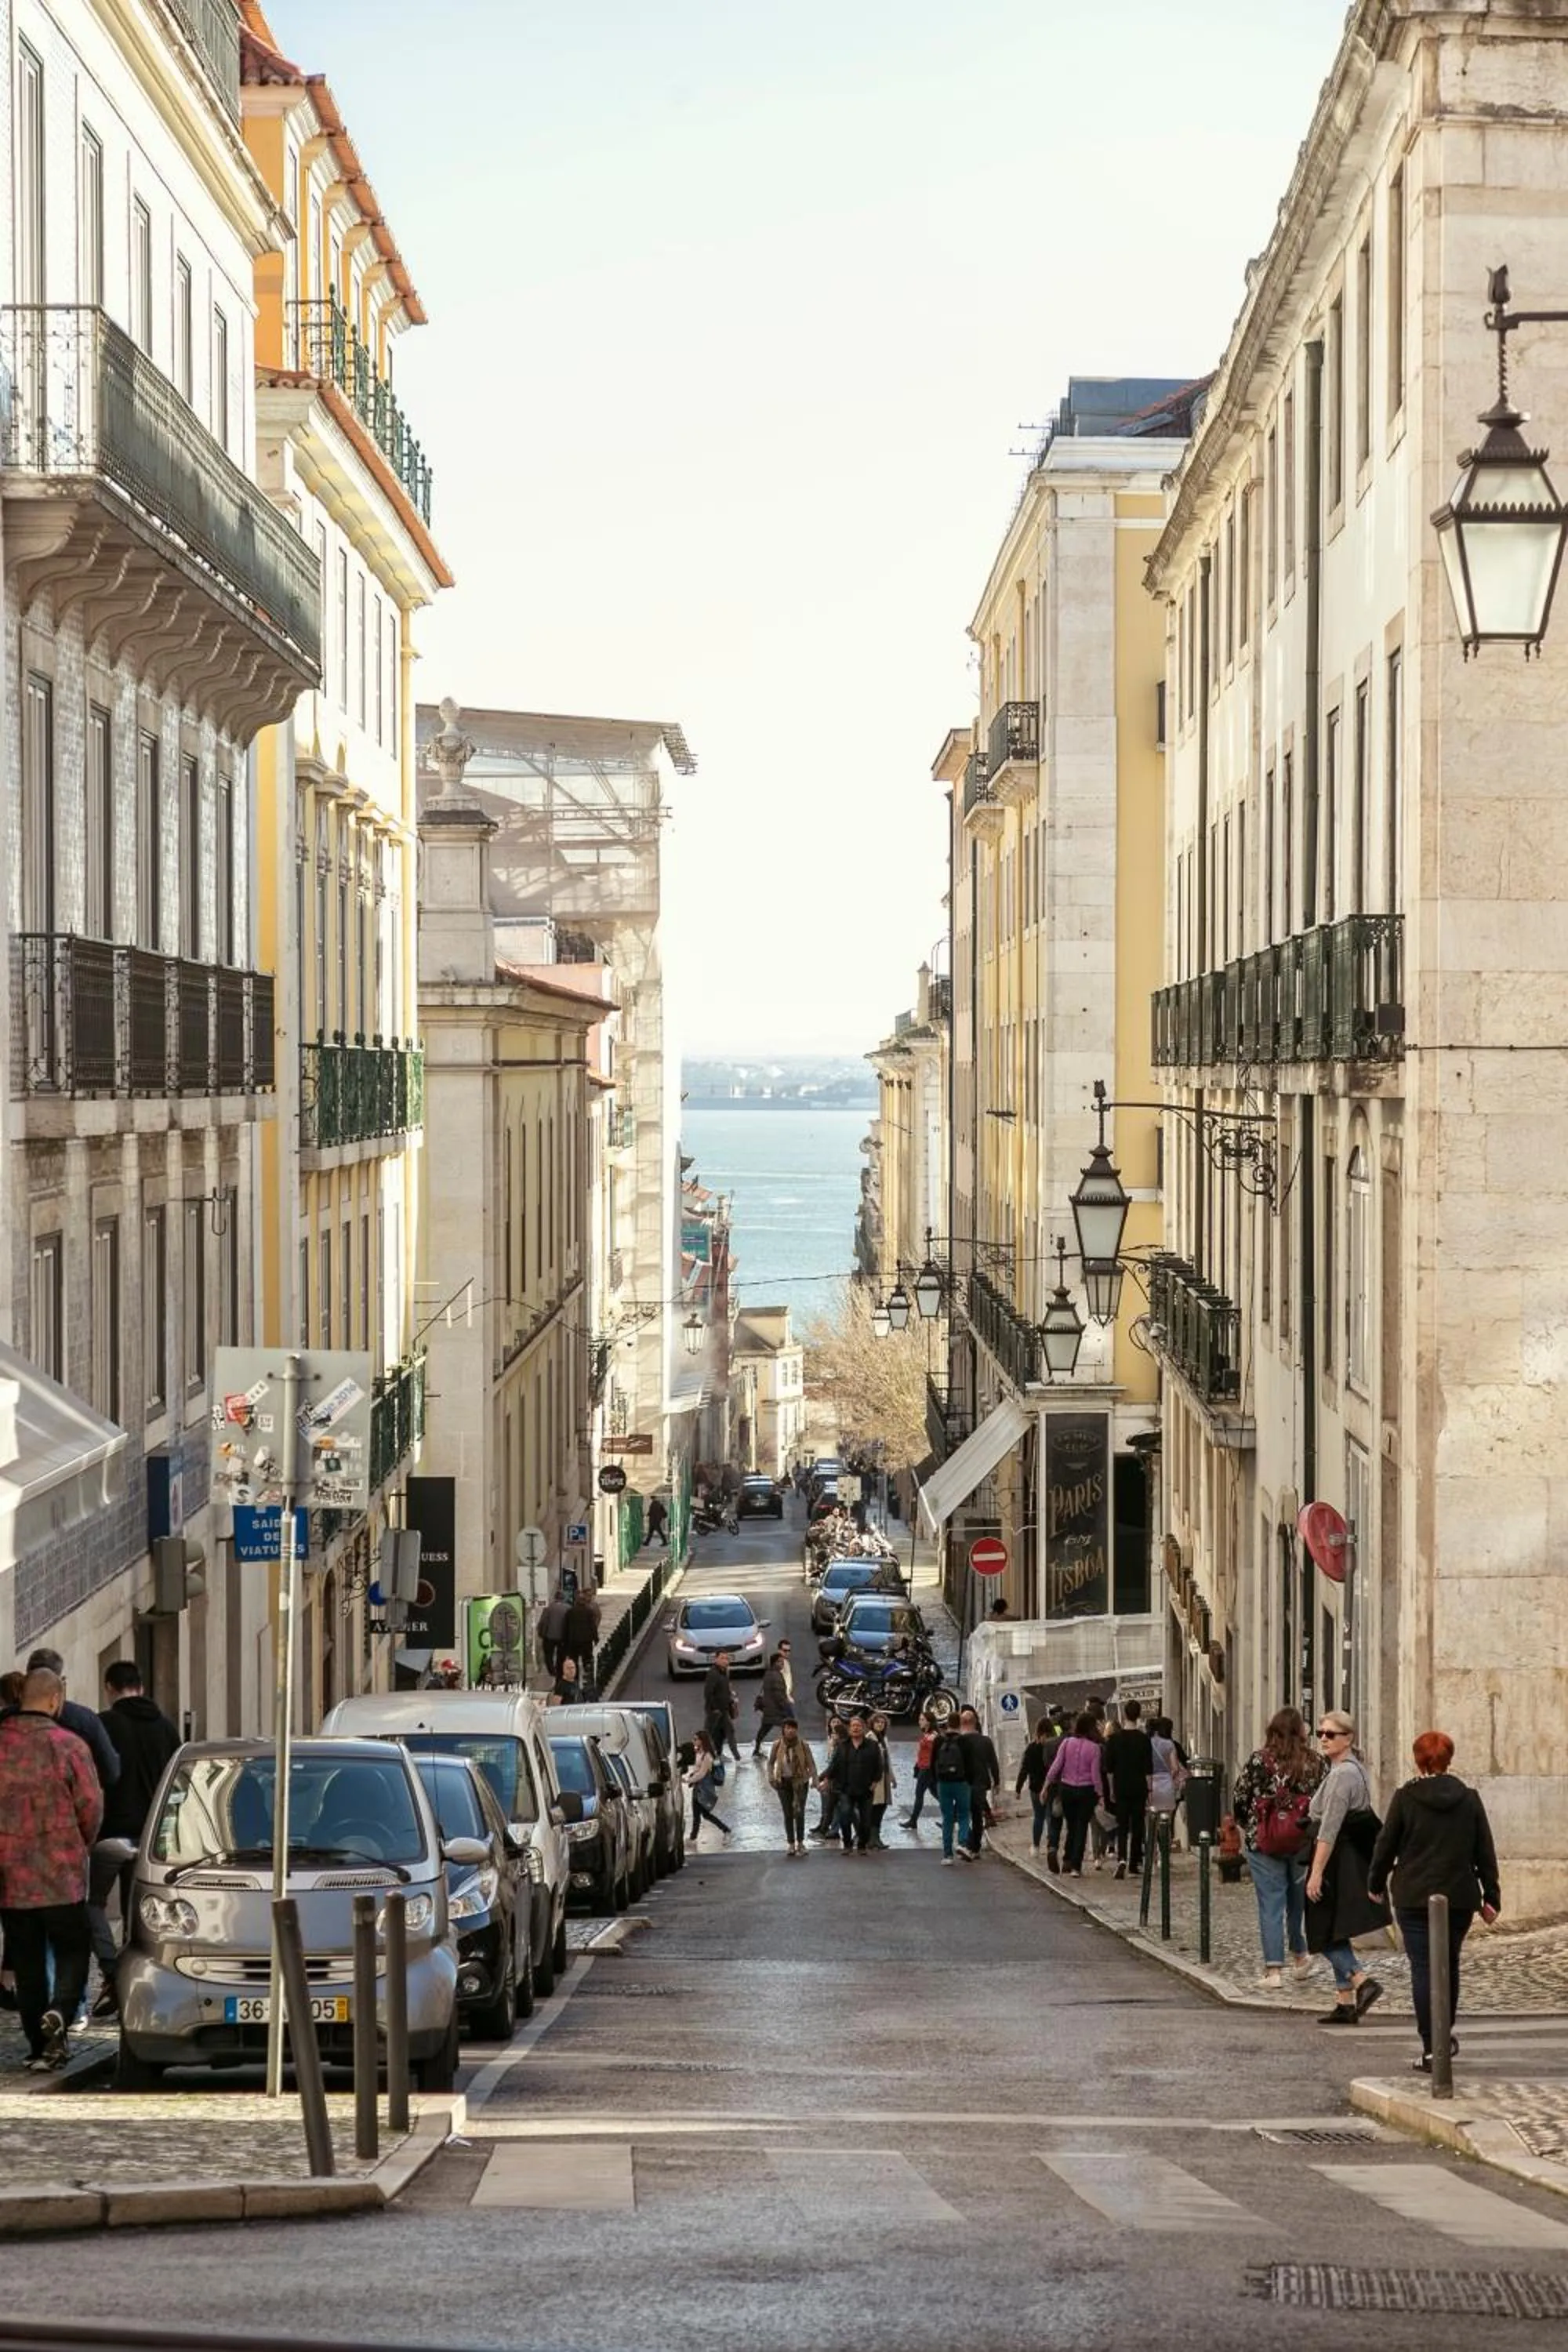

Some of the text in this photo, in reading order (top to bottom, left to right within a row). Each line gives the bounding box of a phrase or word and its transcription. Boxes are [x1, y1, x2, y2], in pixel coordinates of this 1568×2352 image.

[1049, 1474, 1102, 1537] PARIS
[252, 1516, 281, 1530] SAÍD
[240, 1543, 305, 1556] VIATUS
[421, 1552, 448, 1563] UESS
[1048, 1546, 1104, 1611] LISBOA
